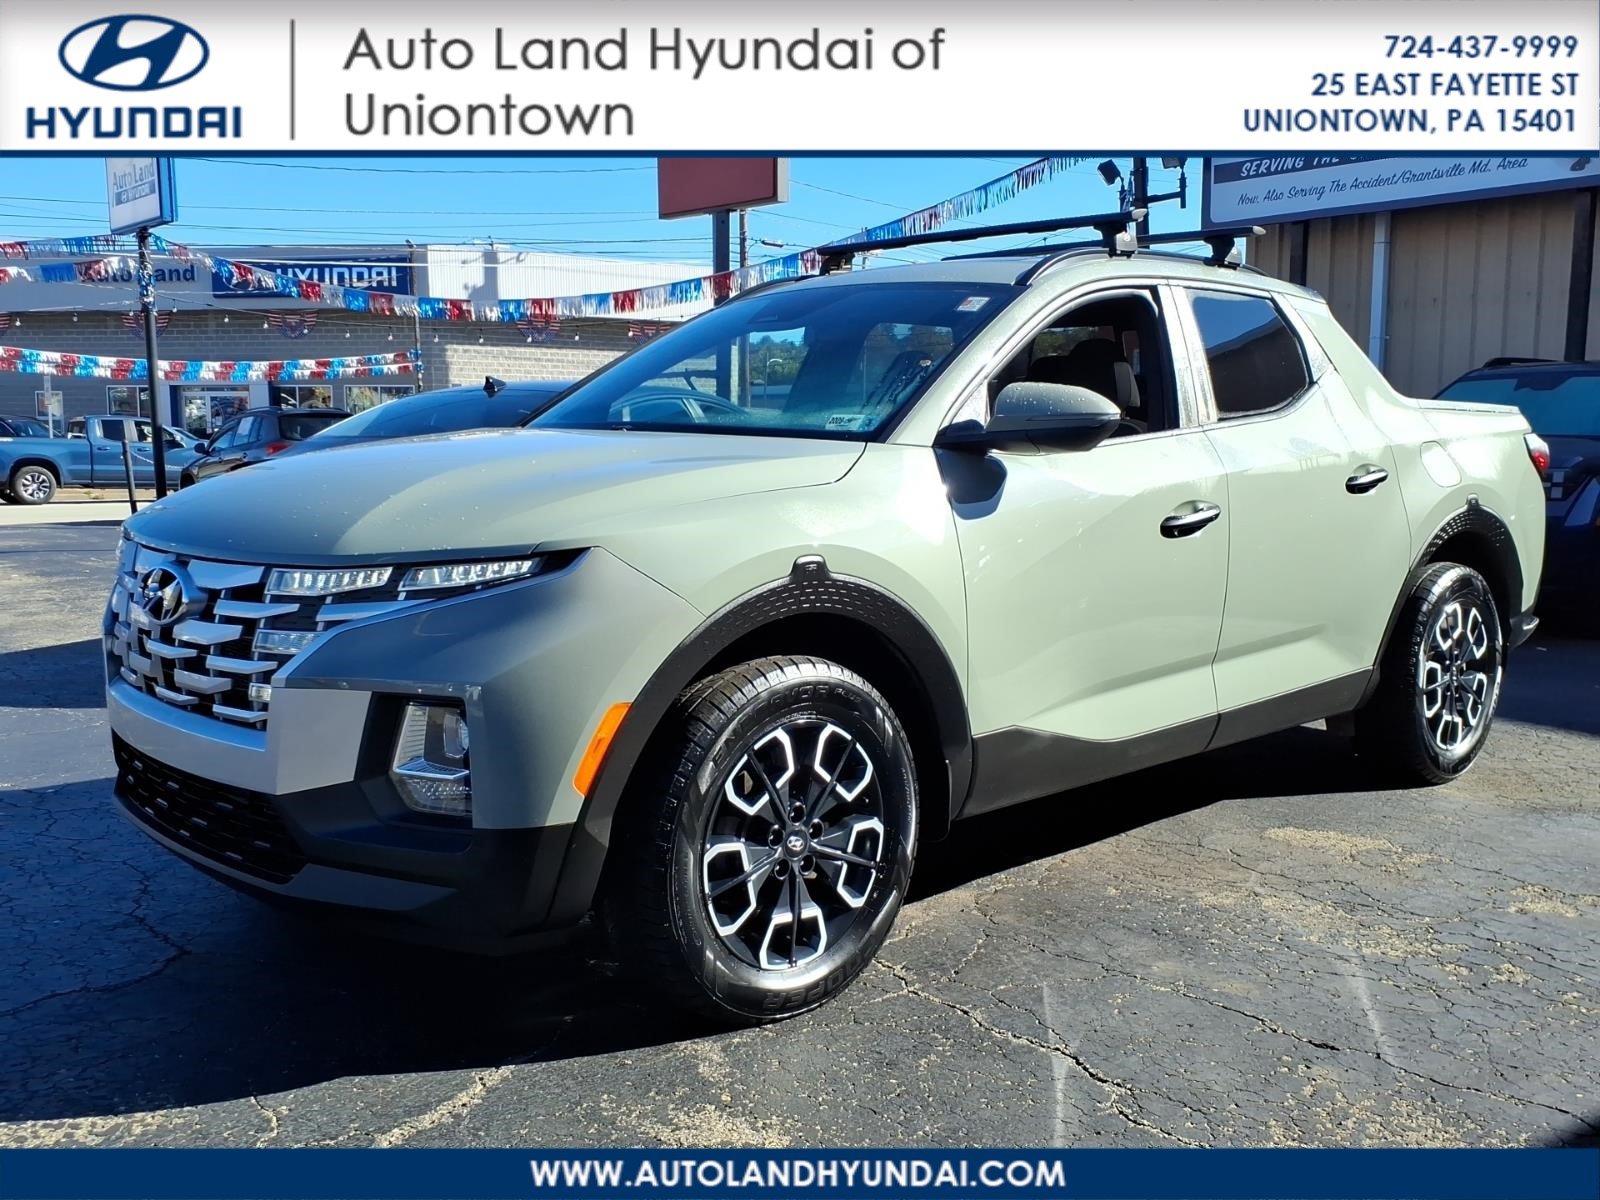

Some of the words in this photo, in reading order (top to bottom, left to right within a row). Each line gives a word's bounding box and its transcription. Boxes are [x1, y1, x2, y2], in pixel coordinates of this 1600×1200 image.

[1240, 157, 1304, 177] SERVING
[1263, 188, 1285, 203] Also
[1287, 185, 1327, 201] Serving
[1329, 179, 1347, 193] The
[1468, 158, 1492, 175] Md.
[1497, 157, 1528, 171] Area
